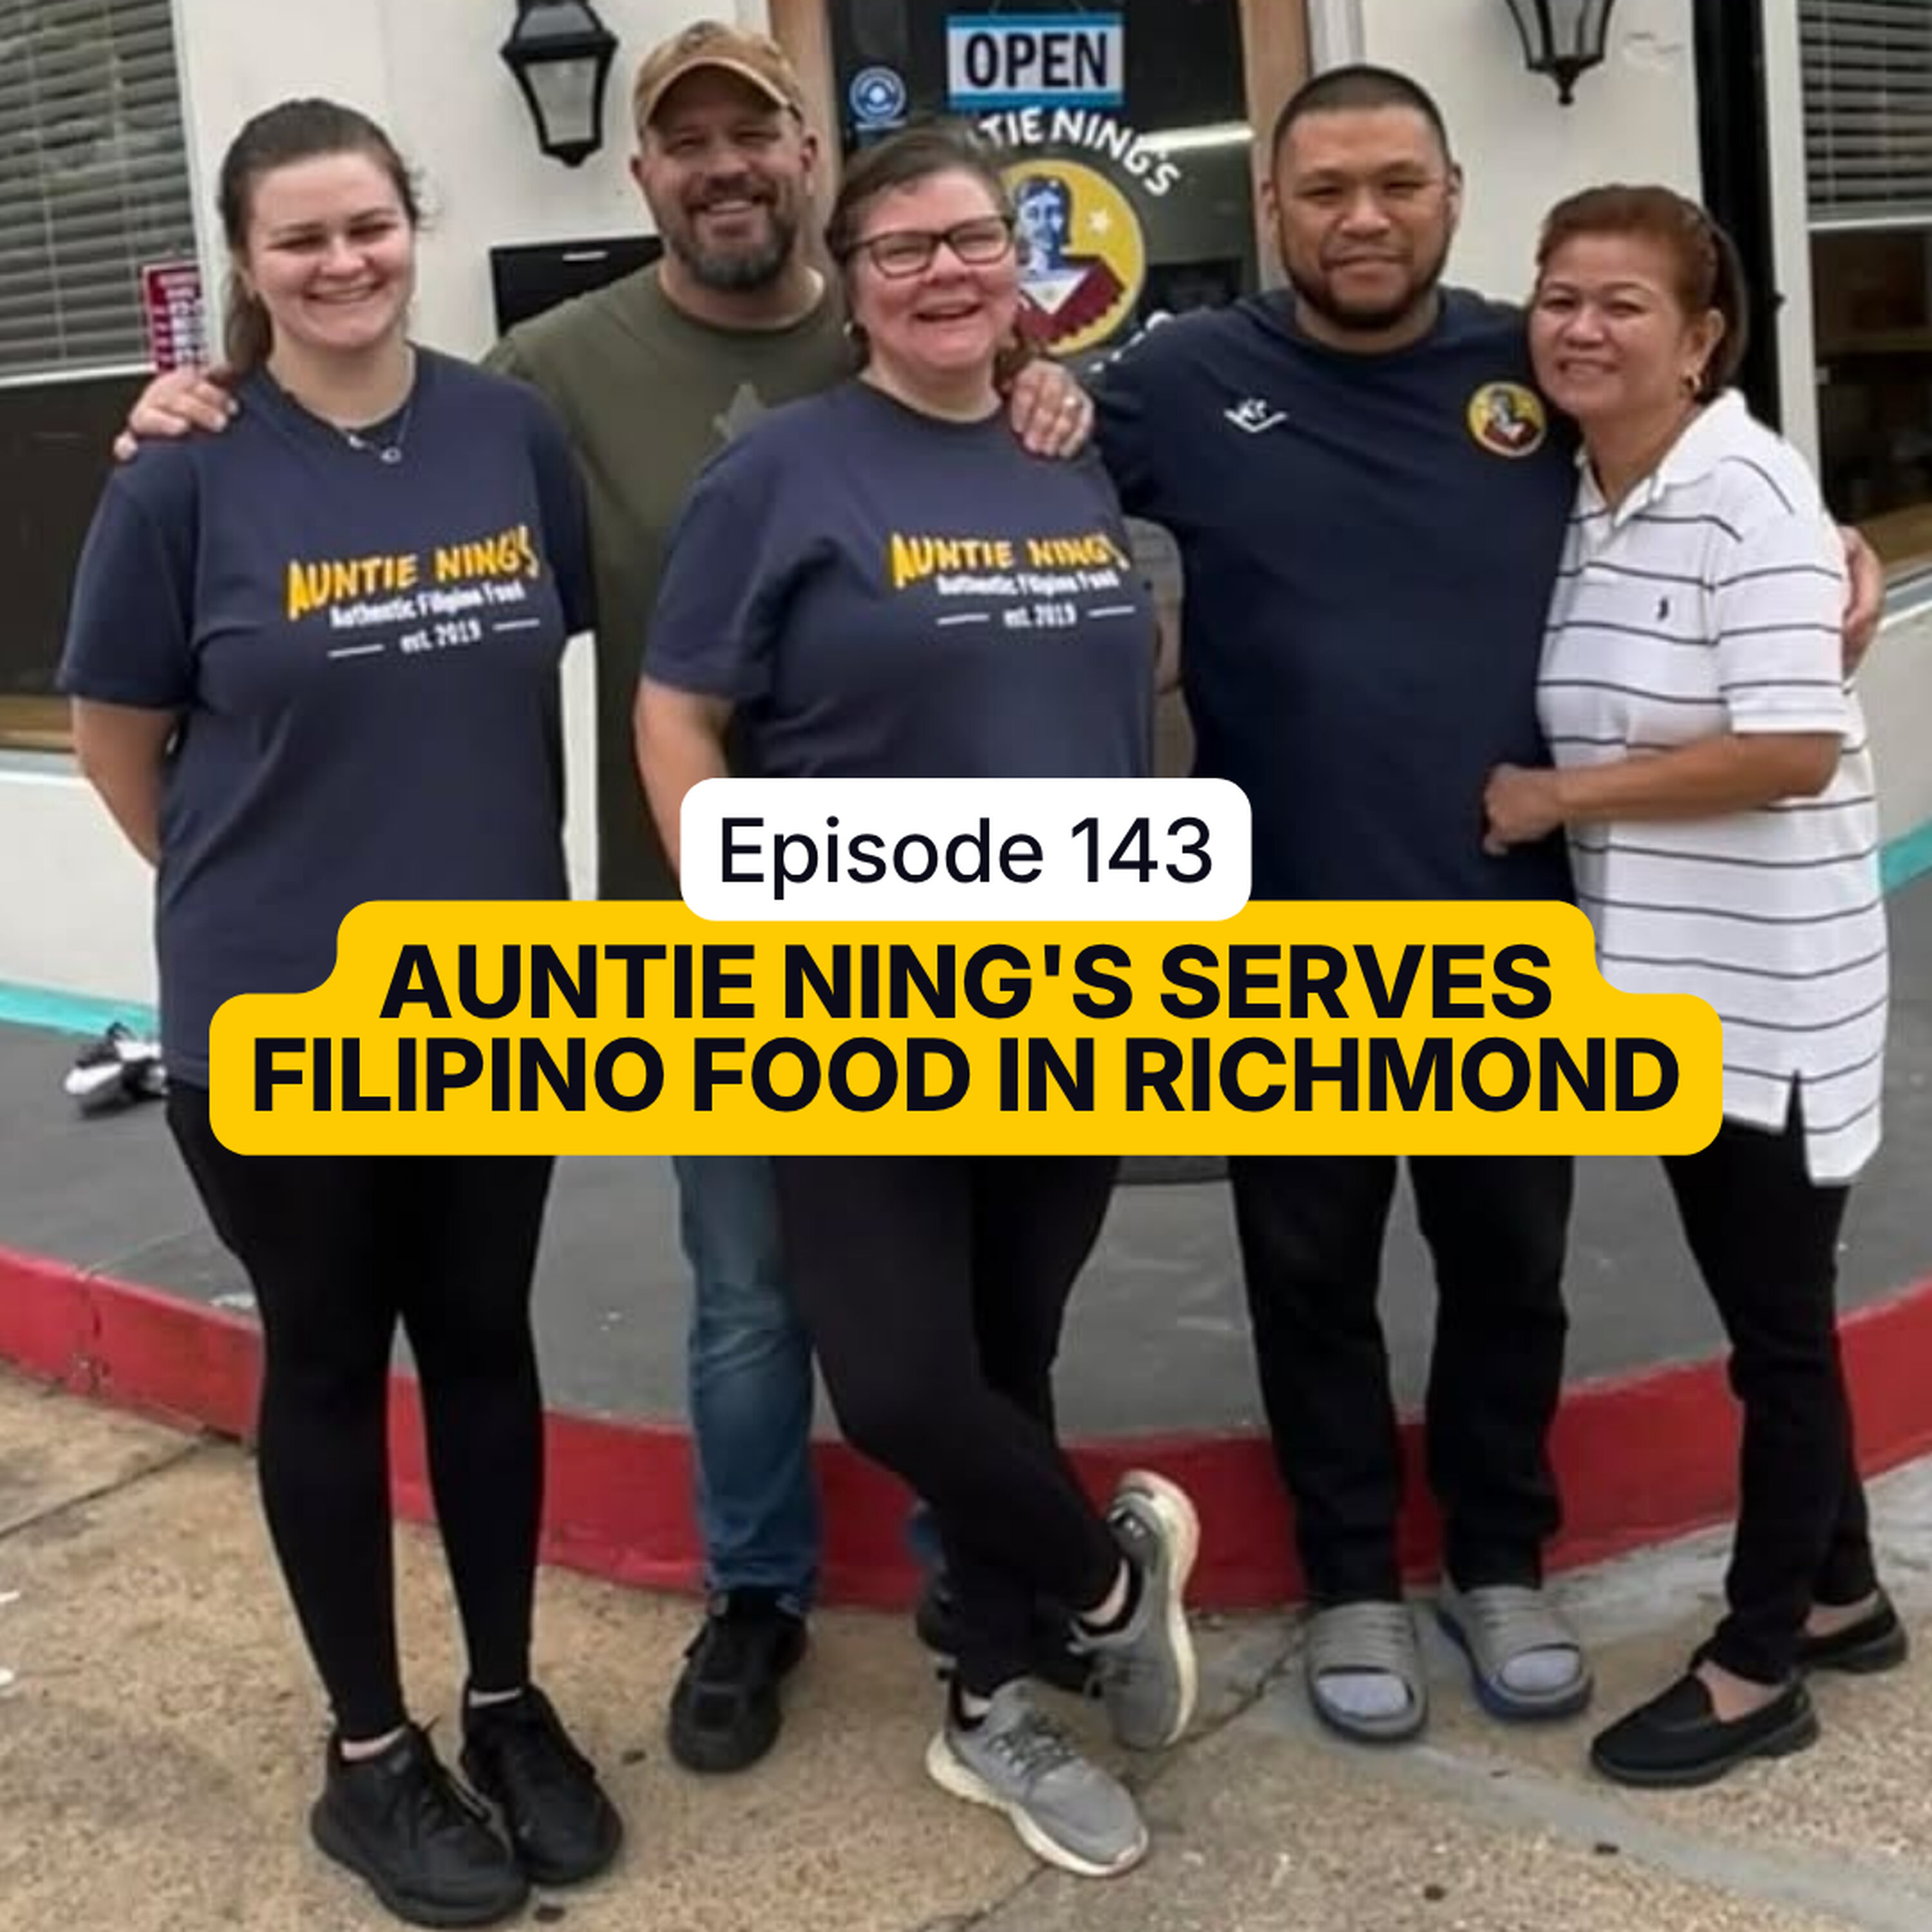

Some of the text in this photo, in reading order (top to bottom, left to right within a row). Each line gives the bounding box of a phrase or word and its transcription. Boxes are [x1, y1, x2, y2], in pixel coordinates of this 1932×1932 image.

[966, 33, 1106, 88] OPEN
[967, 106, 1043, 150] TIE
[288, 554, 419, 621] AUNTIE
[892, 533, 1014, 589] AUNTIE
